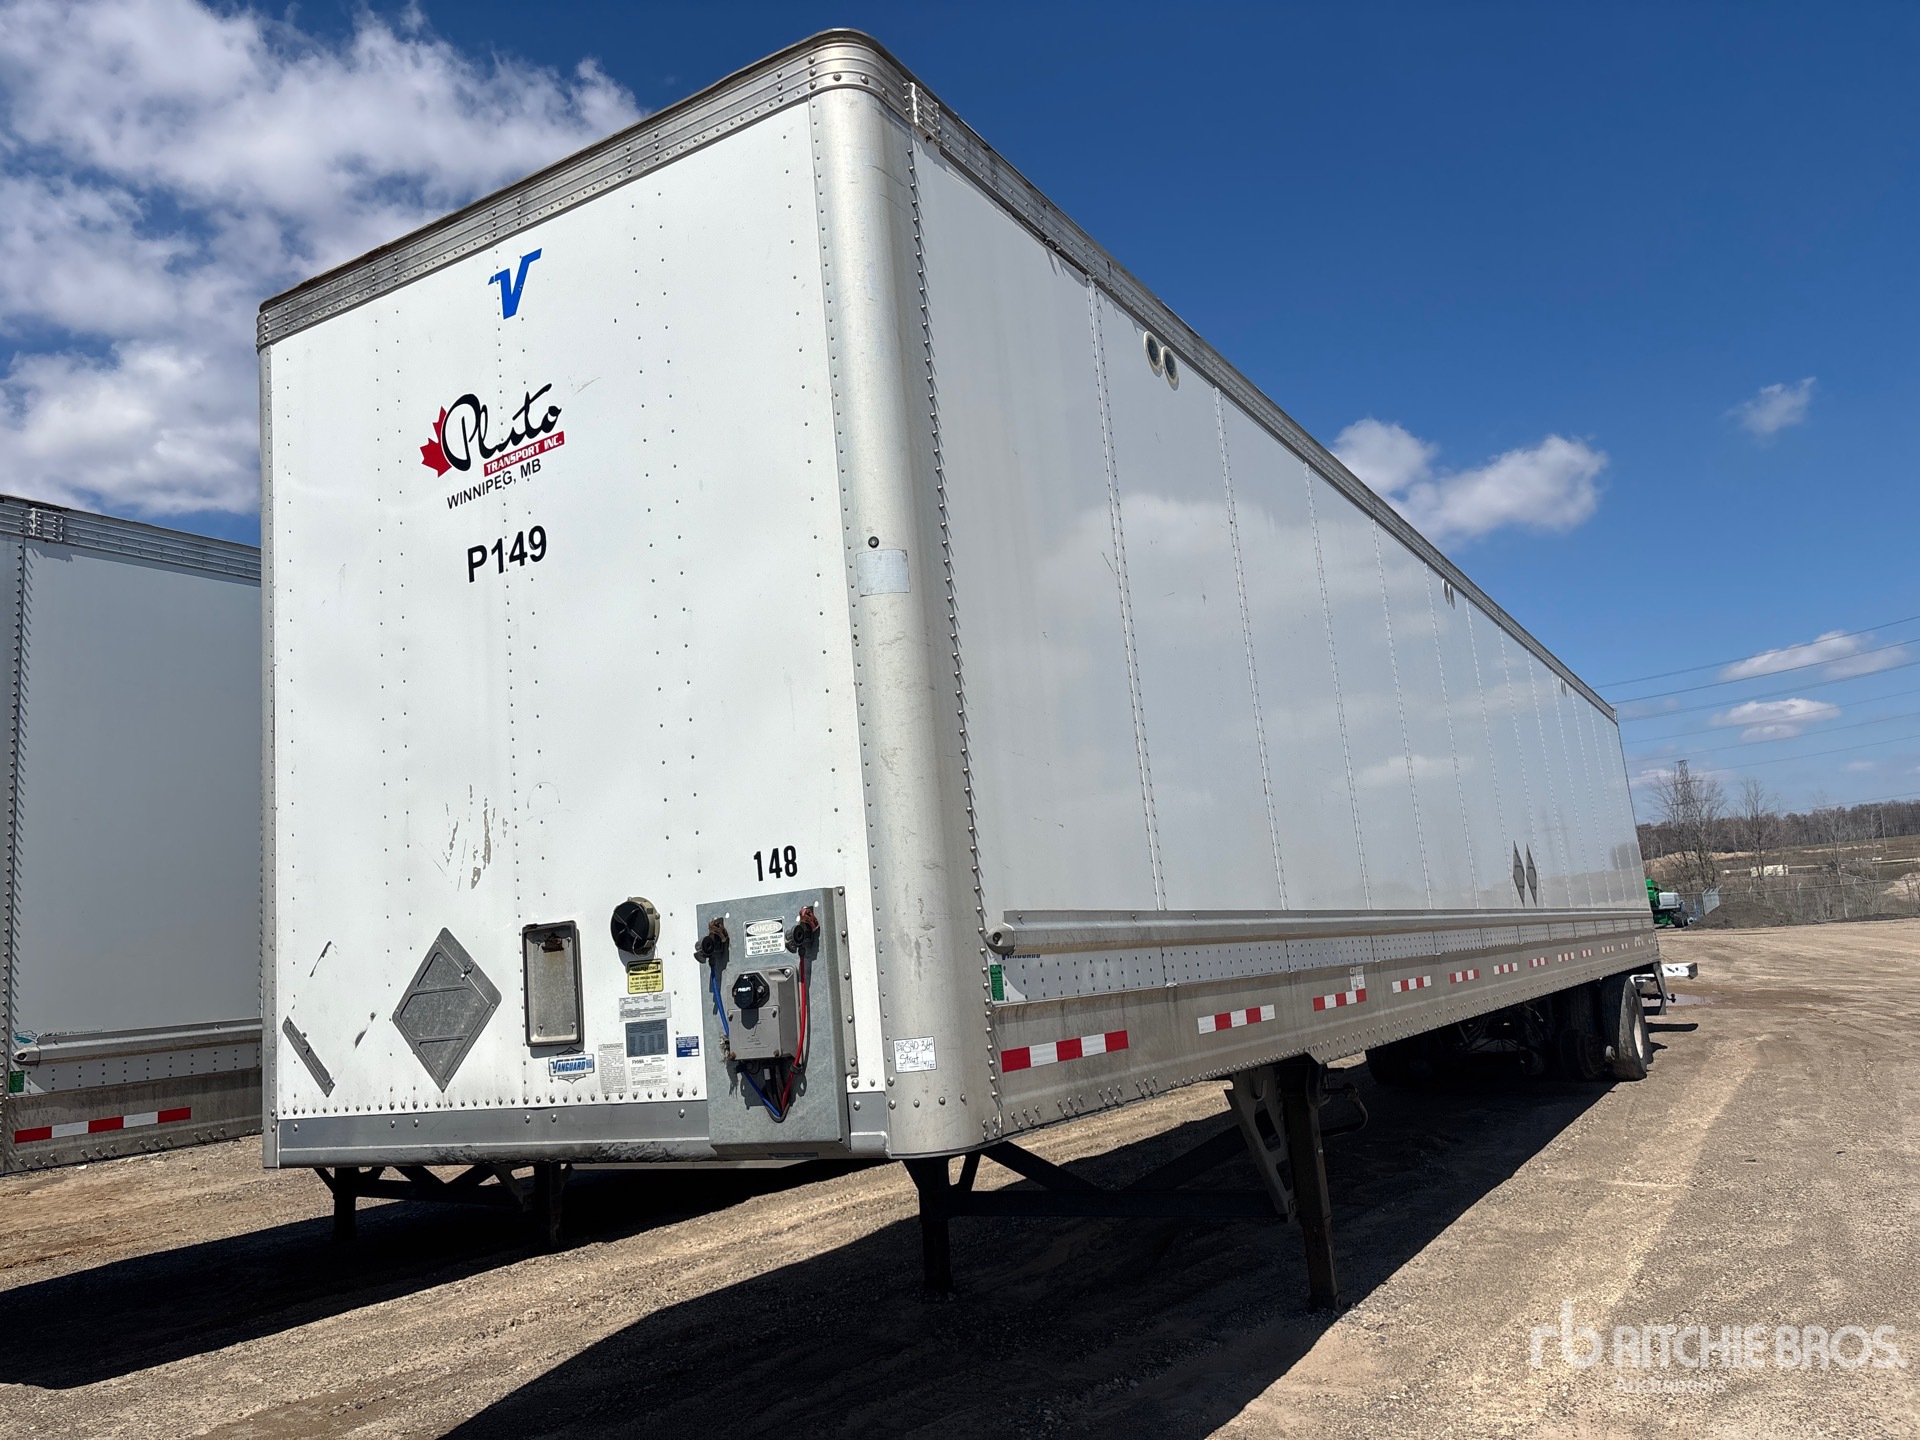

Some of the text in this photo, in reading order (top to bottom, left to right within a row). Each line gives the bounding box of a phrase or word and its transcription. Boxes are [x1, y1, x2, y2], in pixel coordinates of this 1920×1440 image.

[442, 383, 562, 471] Pluto
[486, 435, 562, 474] TRANSPORT INC.
[447, 458, 541, 509] WINNIPEG, MB
[467, 525, 546, 583] P149
[753, 845, 798, 882] 148
[751, 924, 778, 933] DANGER
[550, 1057, 586, 1073] VANGUARD
